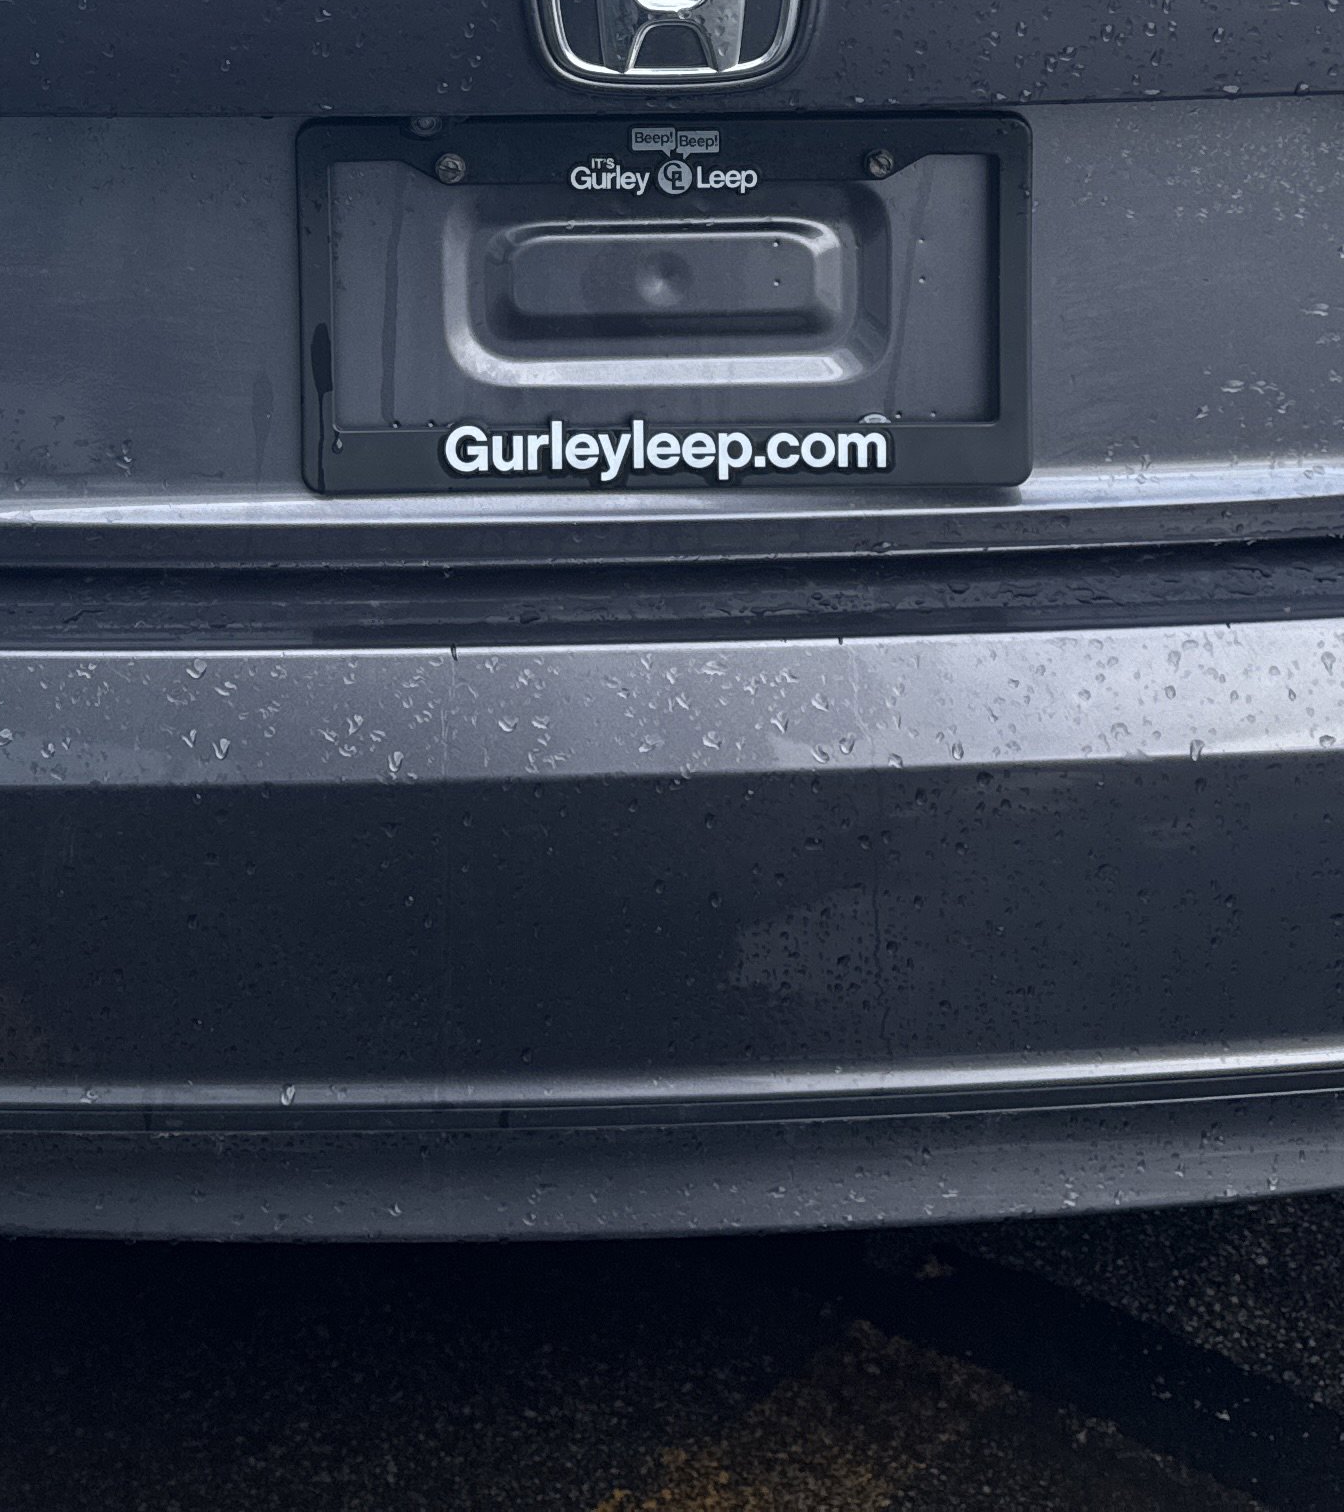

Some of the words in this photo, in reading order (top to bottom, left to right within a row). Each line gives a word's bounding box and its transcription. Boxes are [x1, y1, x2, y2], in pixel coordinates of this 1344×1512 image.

[634, 131, 673, 146] Beep!
[679, 134, 719, 150] Beep!
[591, 157, 616, 170] IT'S
[570, 164, 651, 196] Gurley
[696, 165, 758, 194] Leep
[444, 419, 888, 481] Gurleyleep.com
